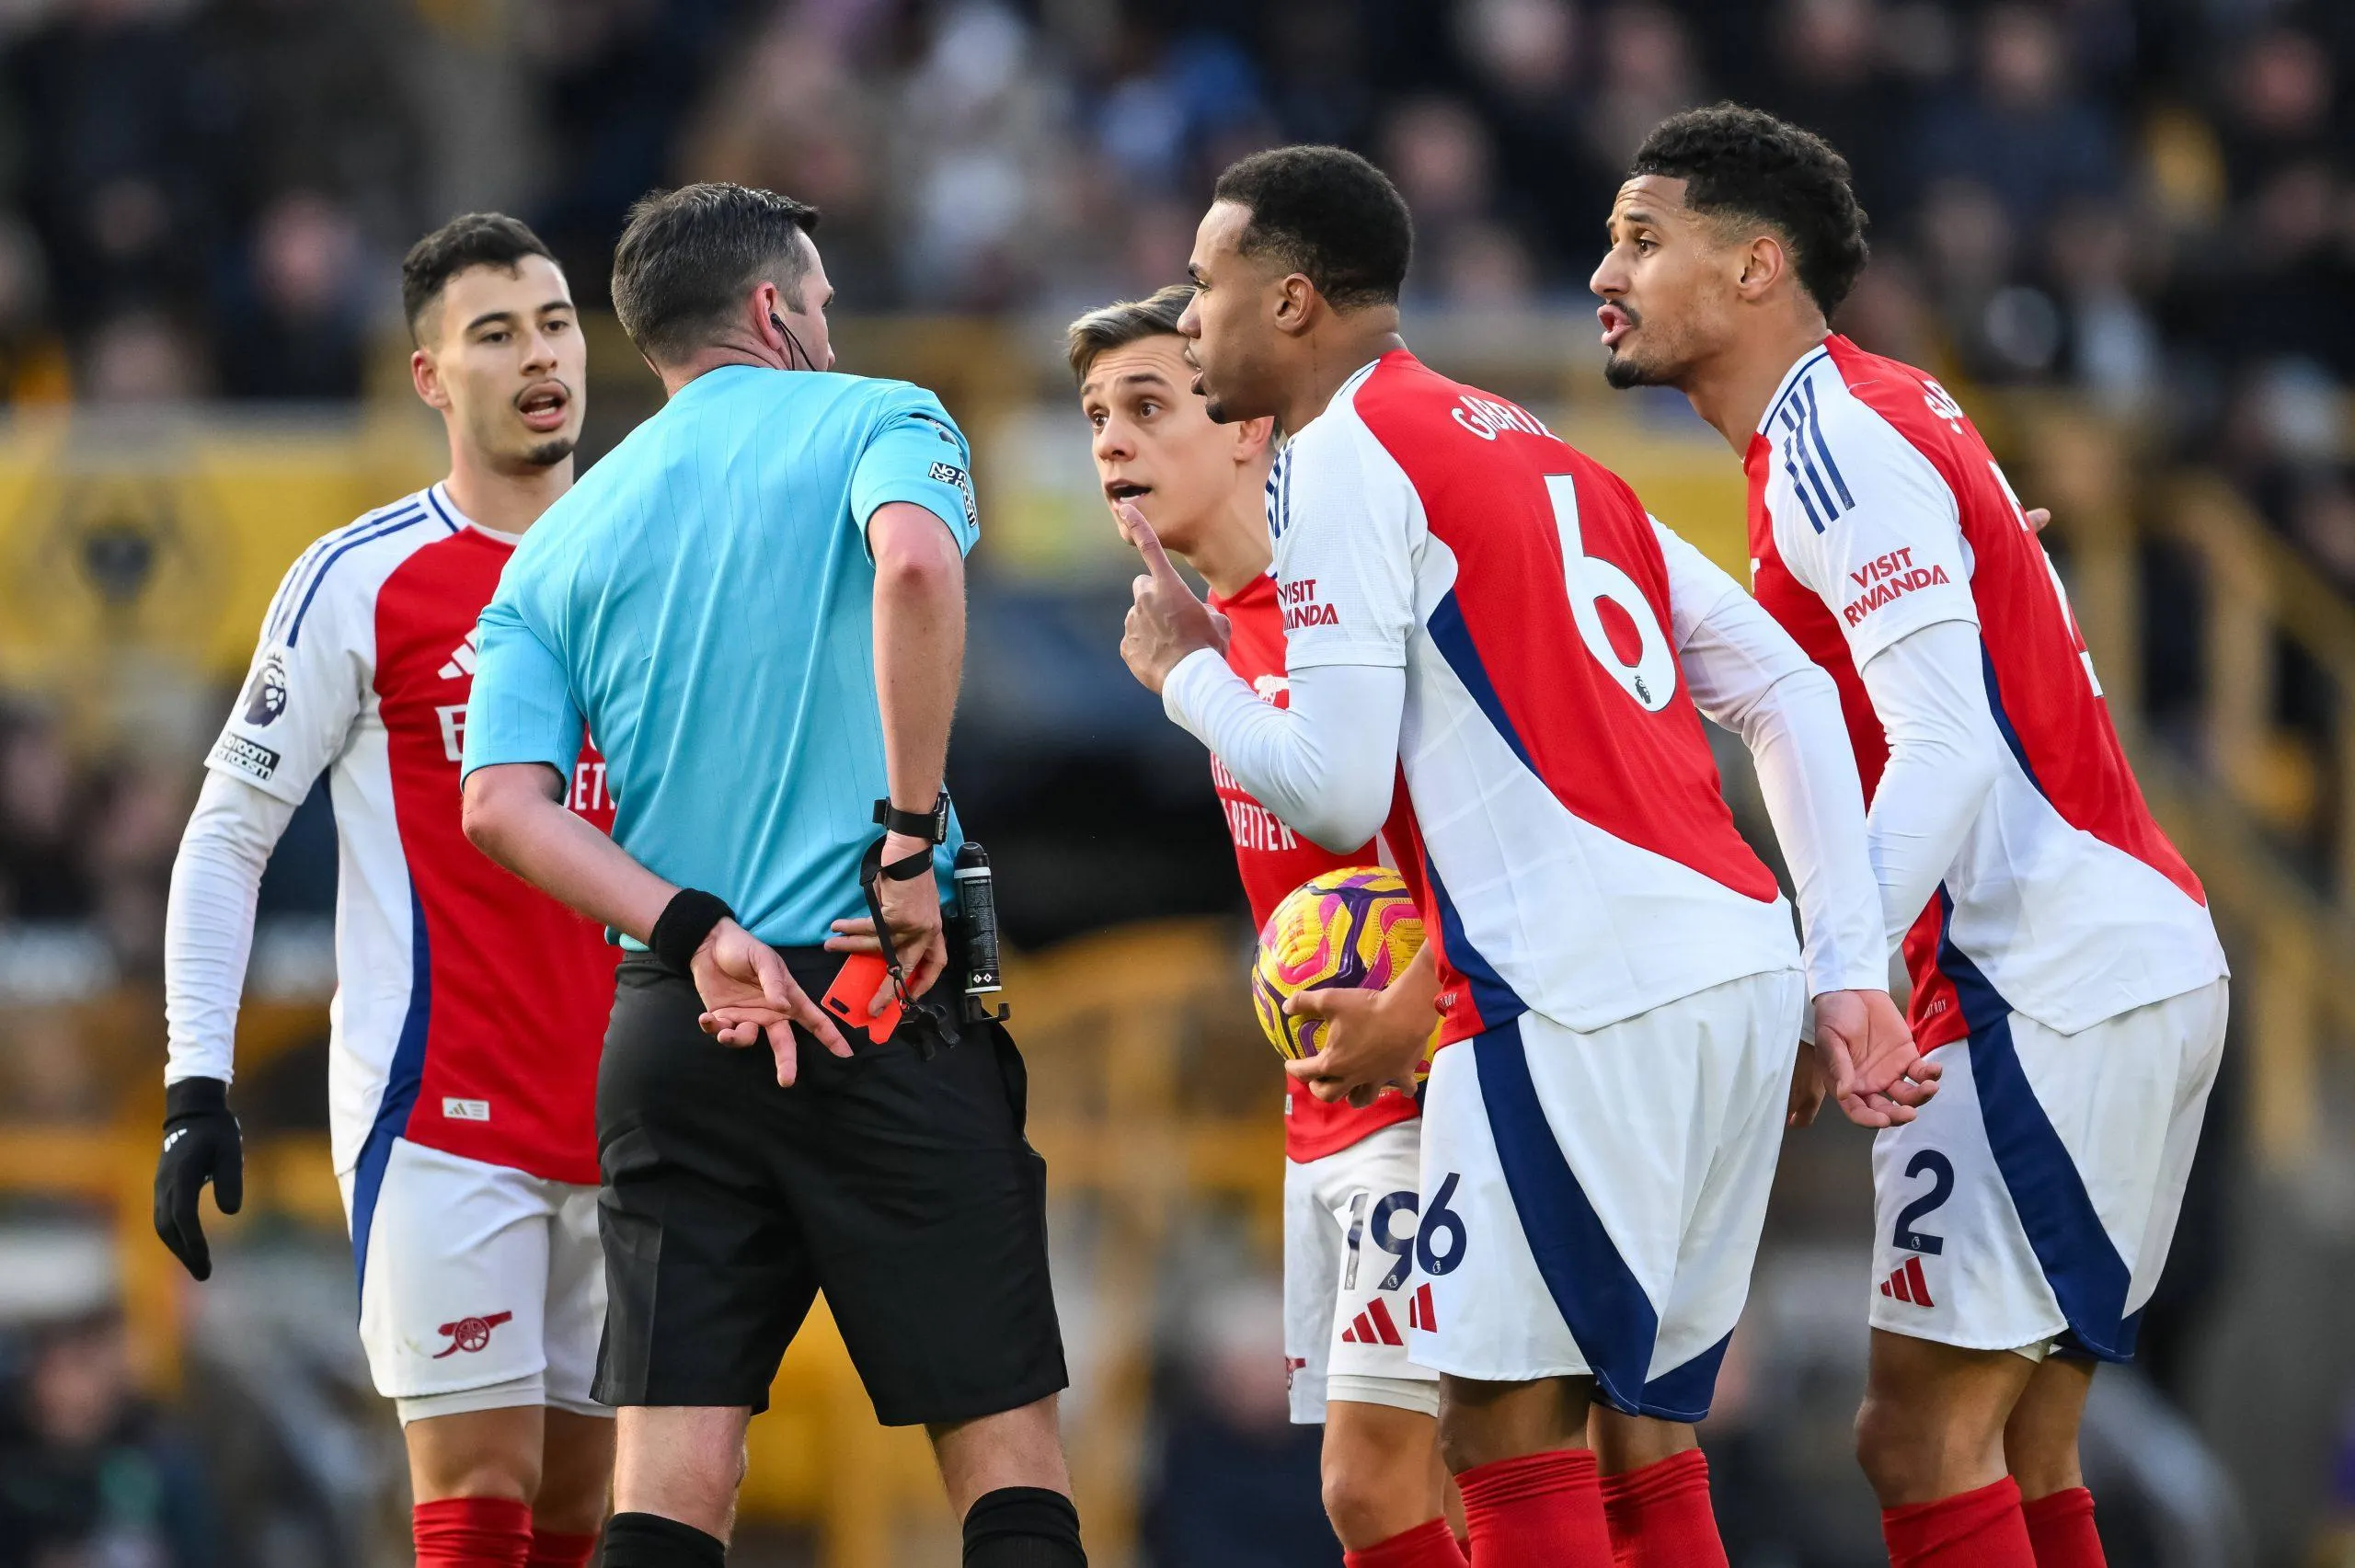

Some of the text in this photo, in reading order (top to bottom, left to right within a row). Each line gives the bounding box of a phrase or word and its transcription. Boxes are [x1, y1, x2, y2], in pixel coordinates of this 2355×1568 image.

[931, 462, 957, 476] No
[1277, 578, 1316, 607] VISIT
[1543, 473, 1676, 713] 6
[1843, 564, 1950, 628] RWANDA
[1849, 546, 1913, 589] VISIT
[1341, 1190, 1419, 1292] 19
[1416, 1172, 1467, 1276] 6
[1892, 1149, 1955, 1255] 2
